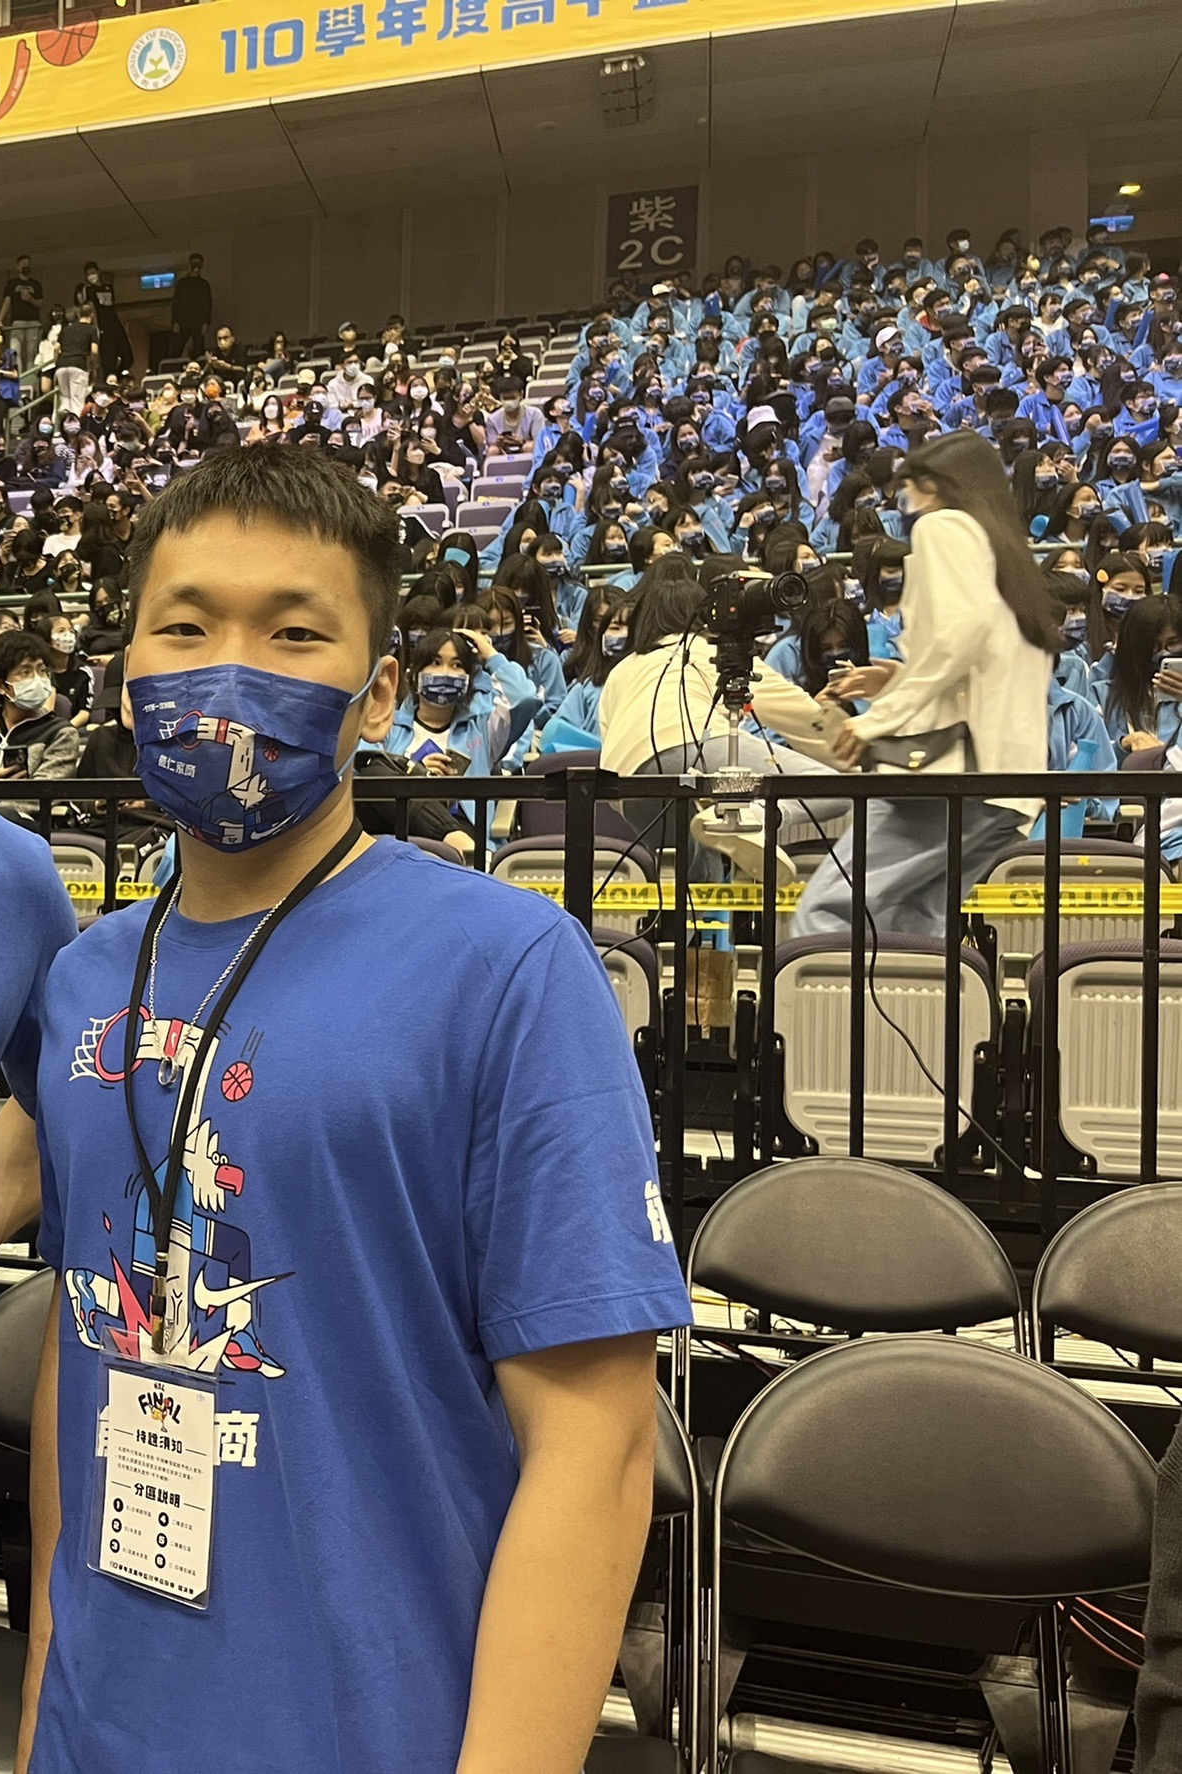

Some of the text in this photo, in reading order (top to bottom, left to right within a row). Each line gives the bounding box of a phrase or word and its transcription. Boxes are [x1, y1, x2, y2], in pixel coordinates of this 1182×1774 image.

[629, 196, 677, 233] 紫
[618, 235, 684, 270] 2C
[138, 1391, 181, 1424] FINAL
